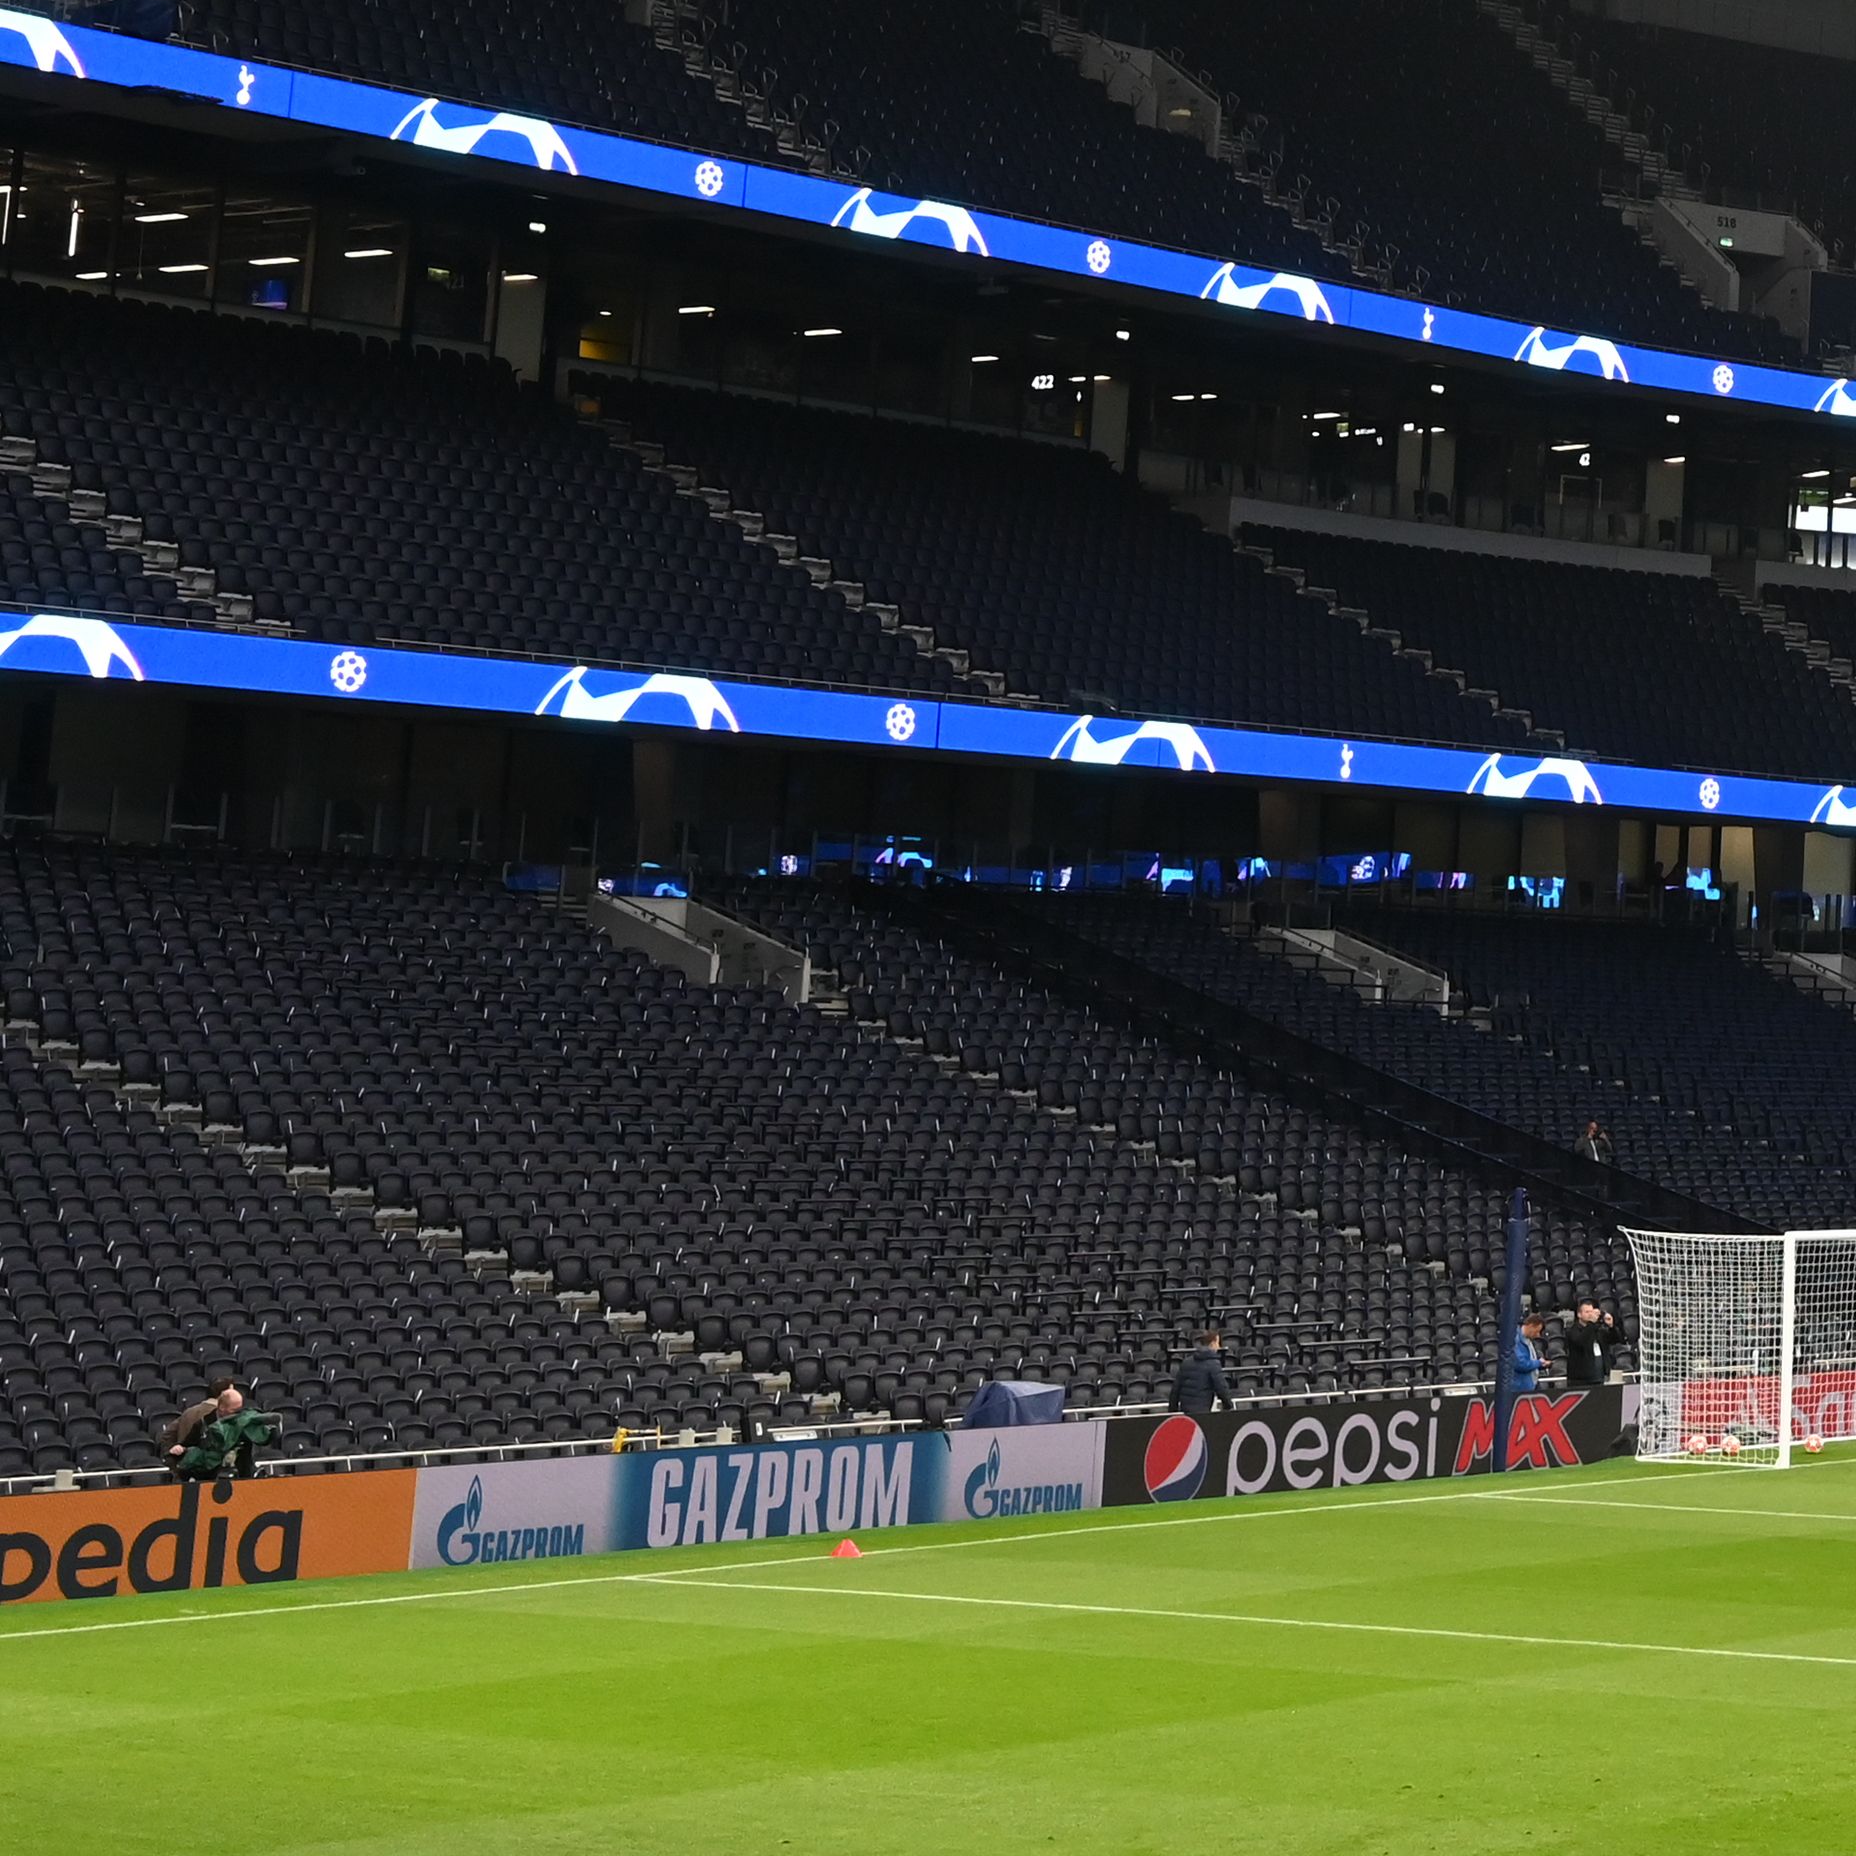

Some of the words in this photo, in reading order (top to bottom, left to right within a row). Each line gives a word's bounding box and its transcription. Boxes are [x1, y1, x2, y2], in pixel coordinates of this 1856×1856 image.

[1717, 216, 1737, 228] 518
[1227, 1397, 1441, 1496] pepsi
[647, 1440, 914, 1549] GAZPROM
[1000, 1482, 1083, 1515] GAZPROM
[480, 1523, 584, 1563] GAZPROM
